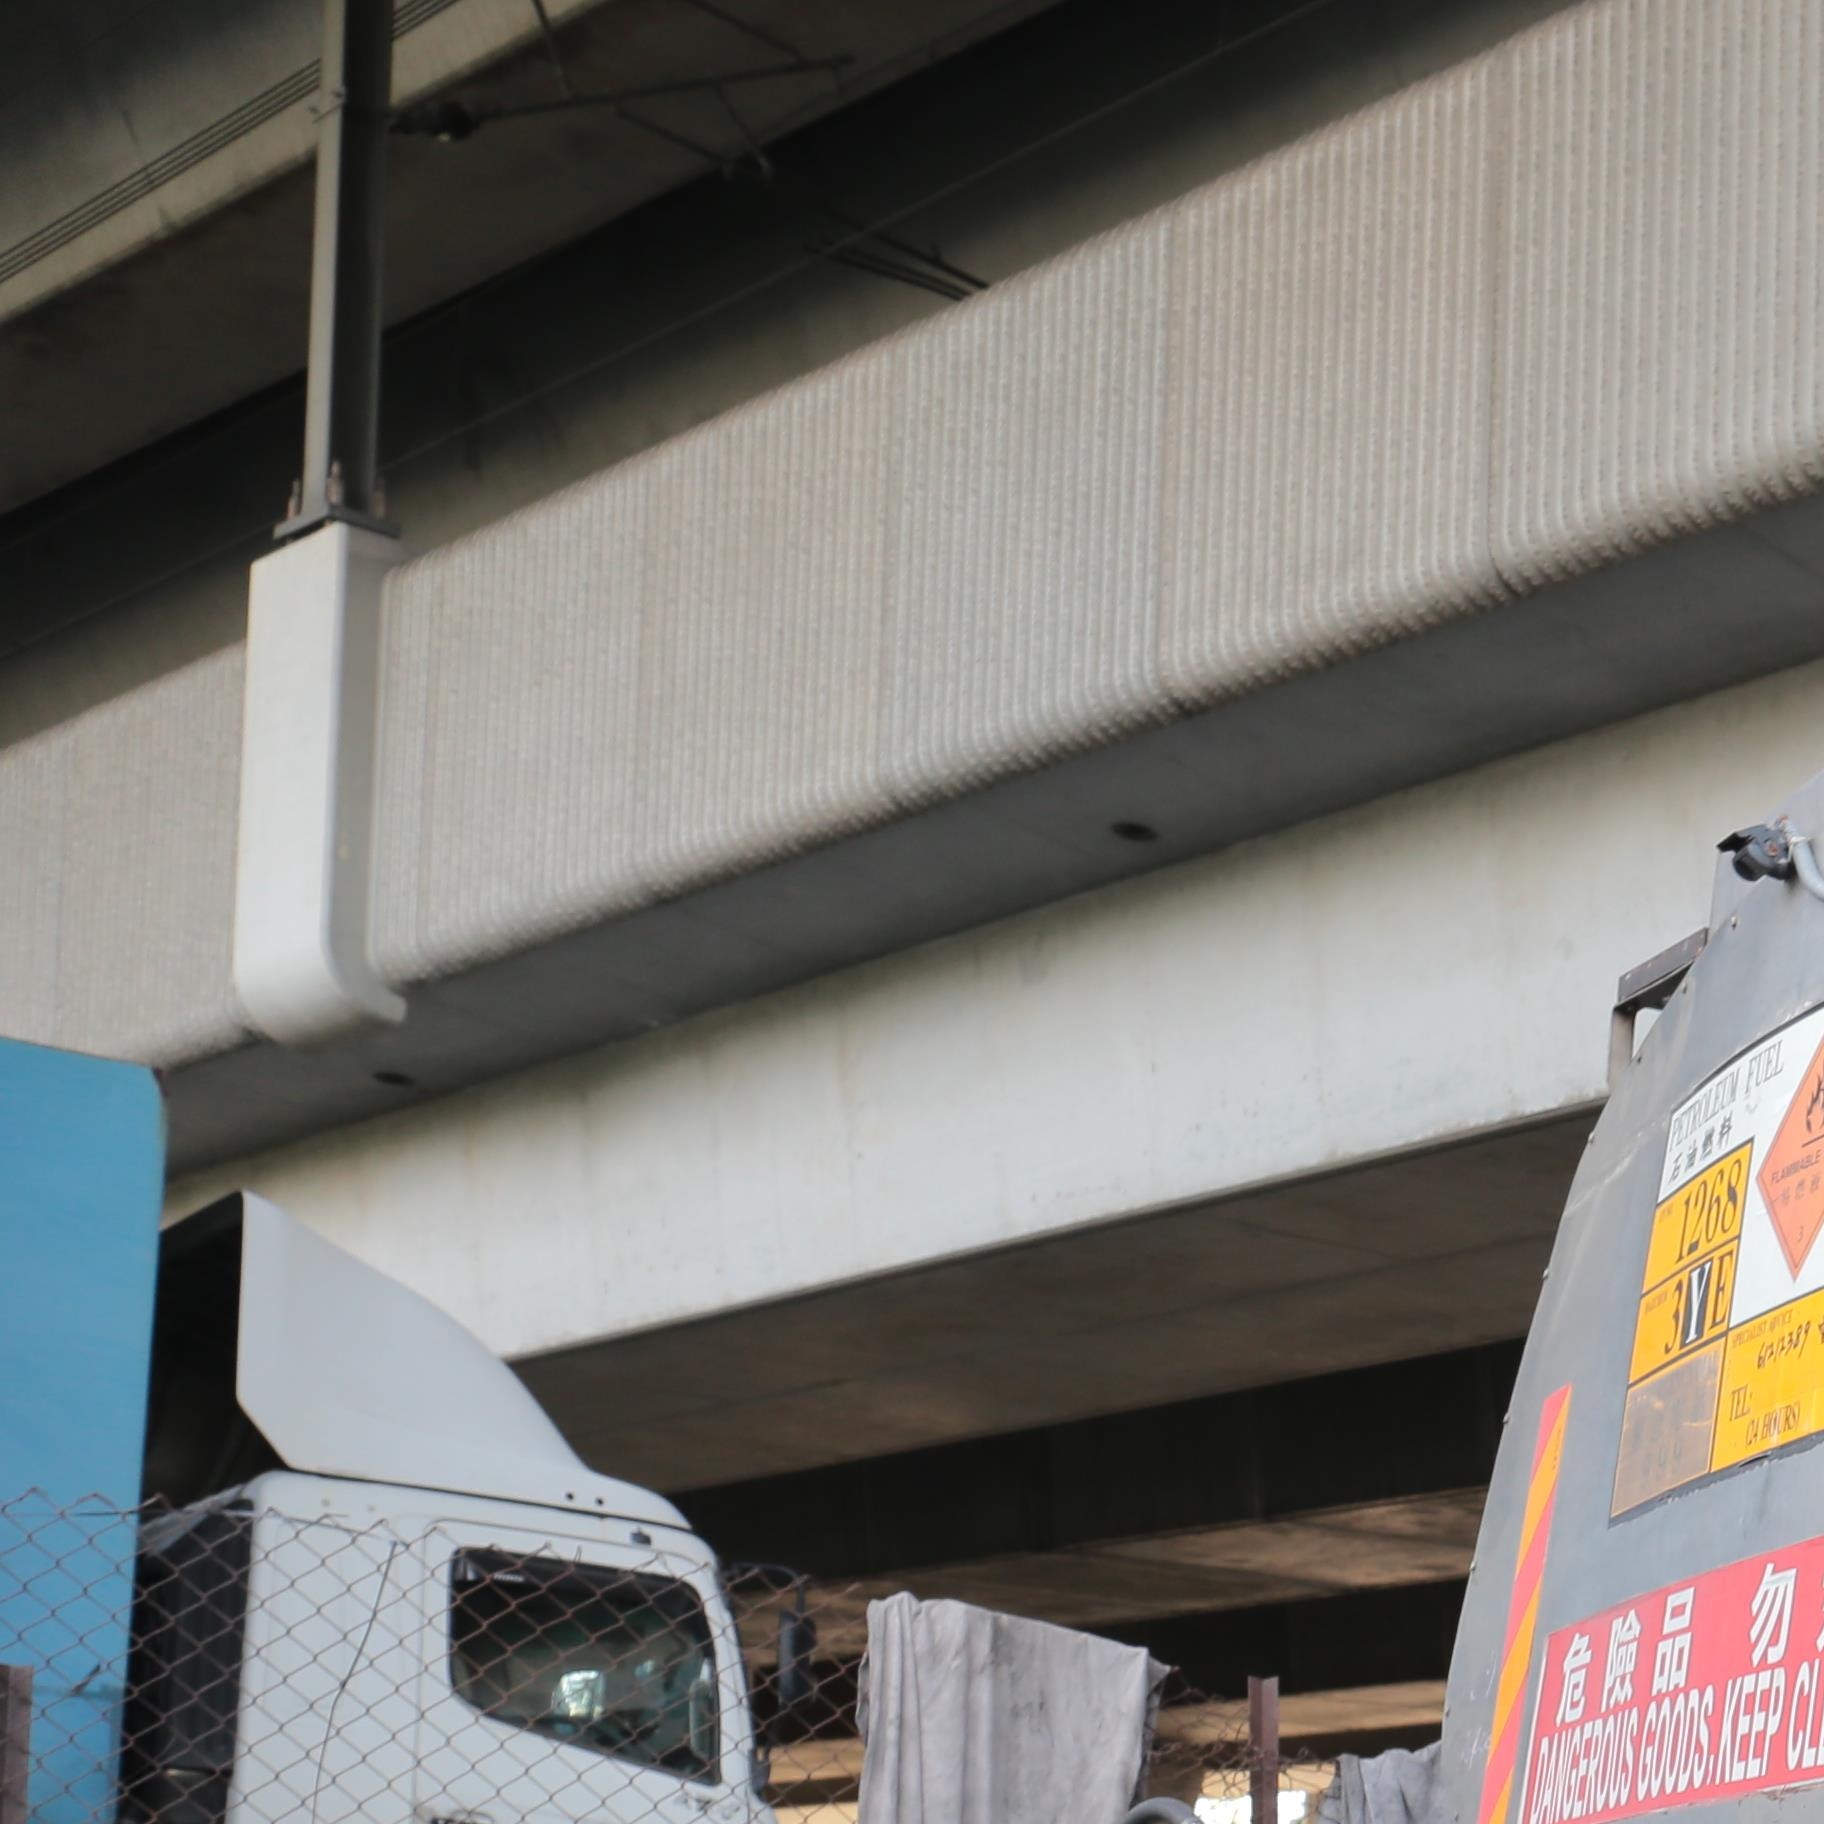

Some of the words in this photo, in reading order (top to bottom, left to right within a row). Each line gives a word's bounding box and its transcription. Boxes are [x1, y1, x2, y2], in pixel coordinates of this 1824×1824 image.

[1668, 1110, 1732, 1184] 石油燃料
[1670, 1067, 1740, 1151] PETROLEUM
[1745, 1040, 1784, 1094] FUEL
[1675, 1158, 1742, 1264] 1268
[1771, 1149, 1821, 1185] FLAMMABLE
[1664, 1249, 1734, 1355] 3YE
[1729, 1384, 1753, 1422] TEL:
[1555, 1586, 1695, 1727] 危險品
[1715, 1667, 1786, 1785] KEEP
